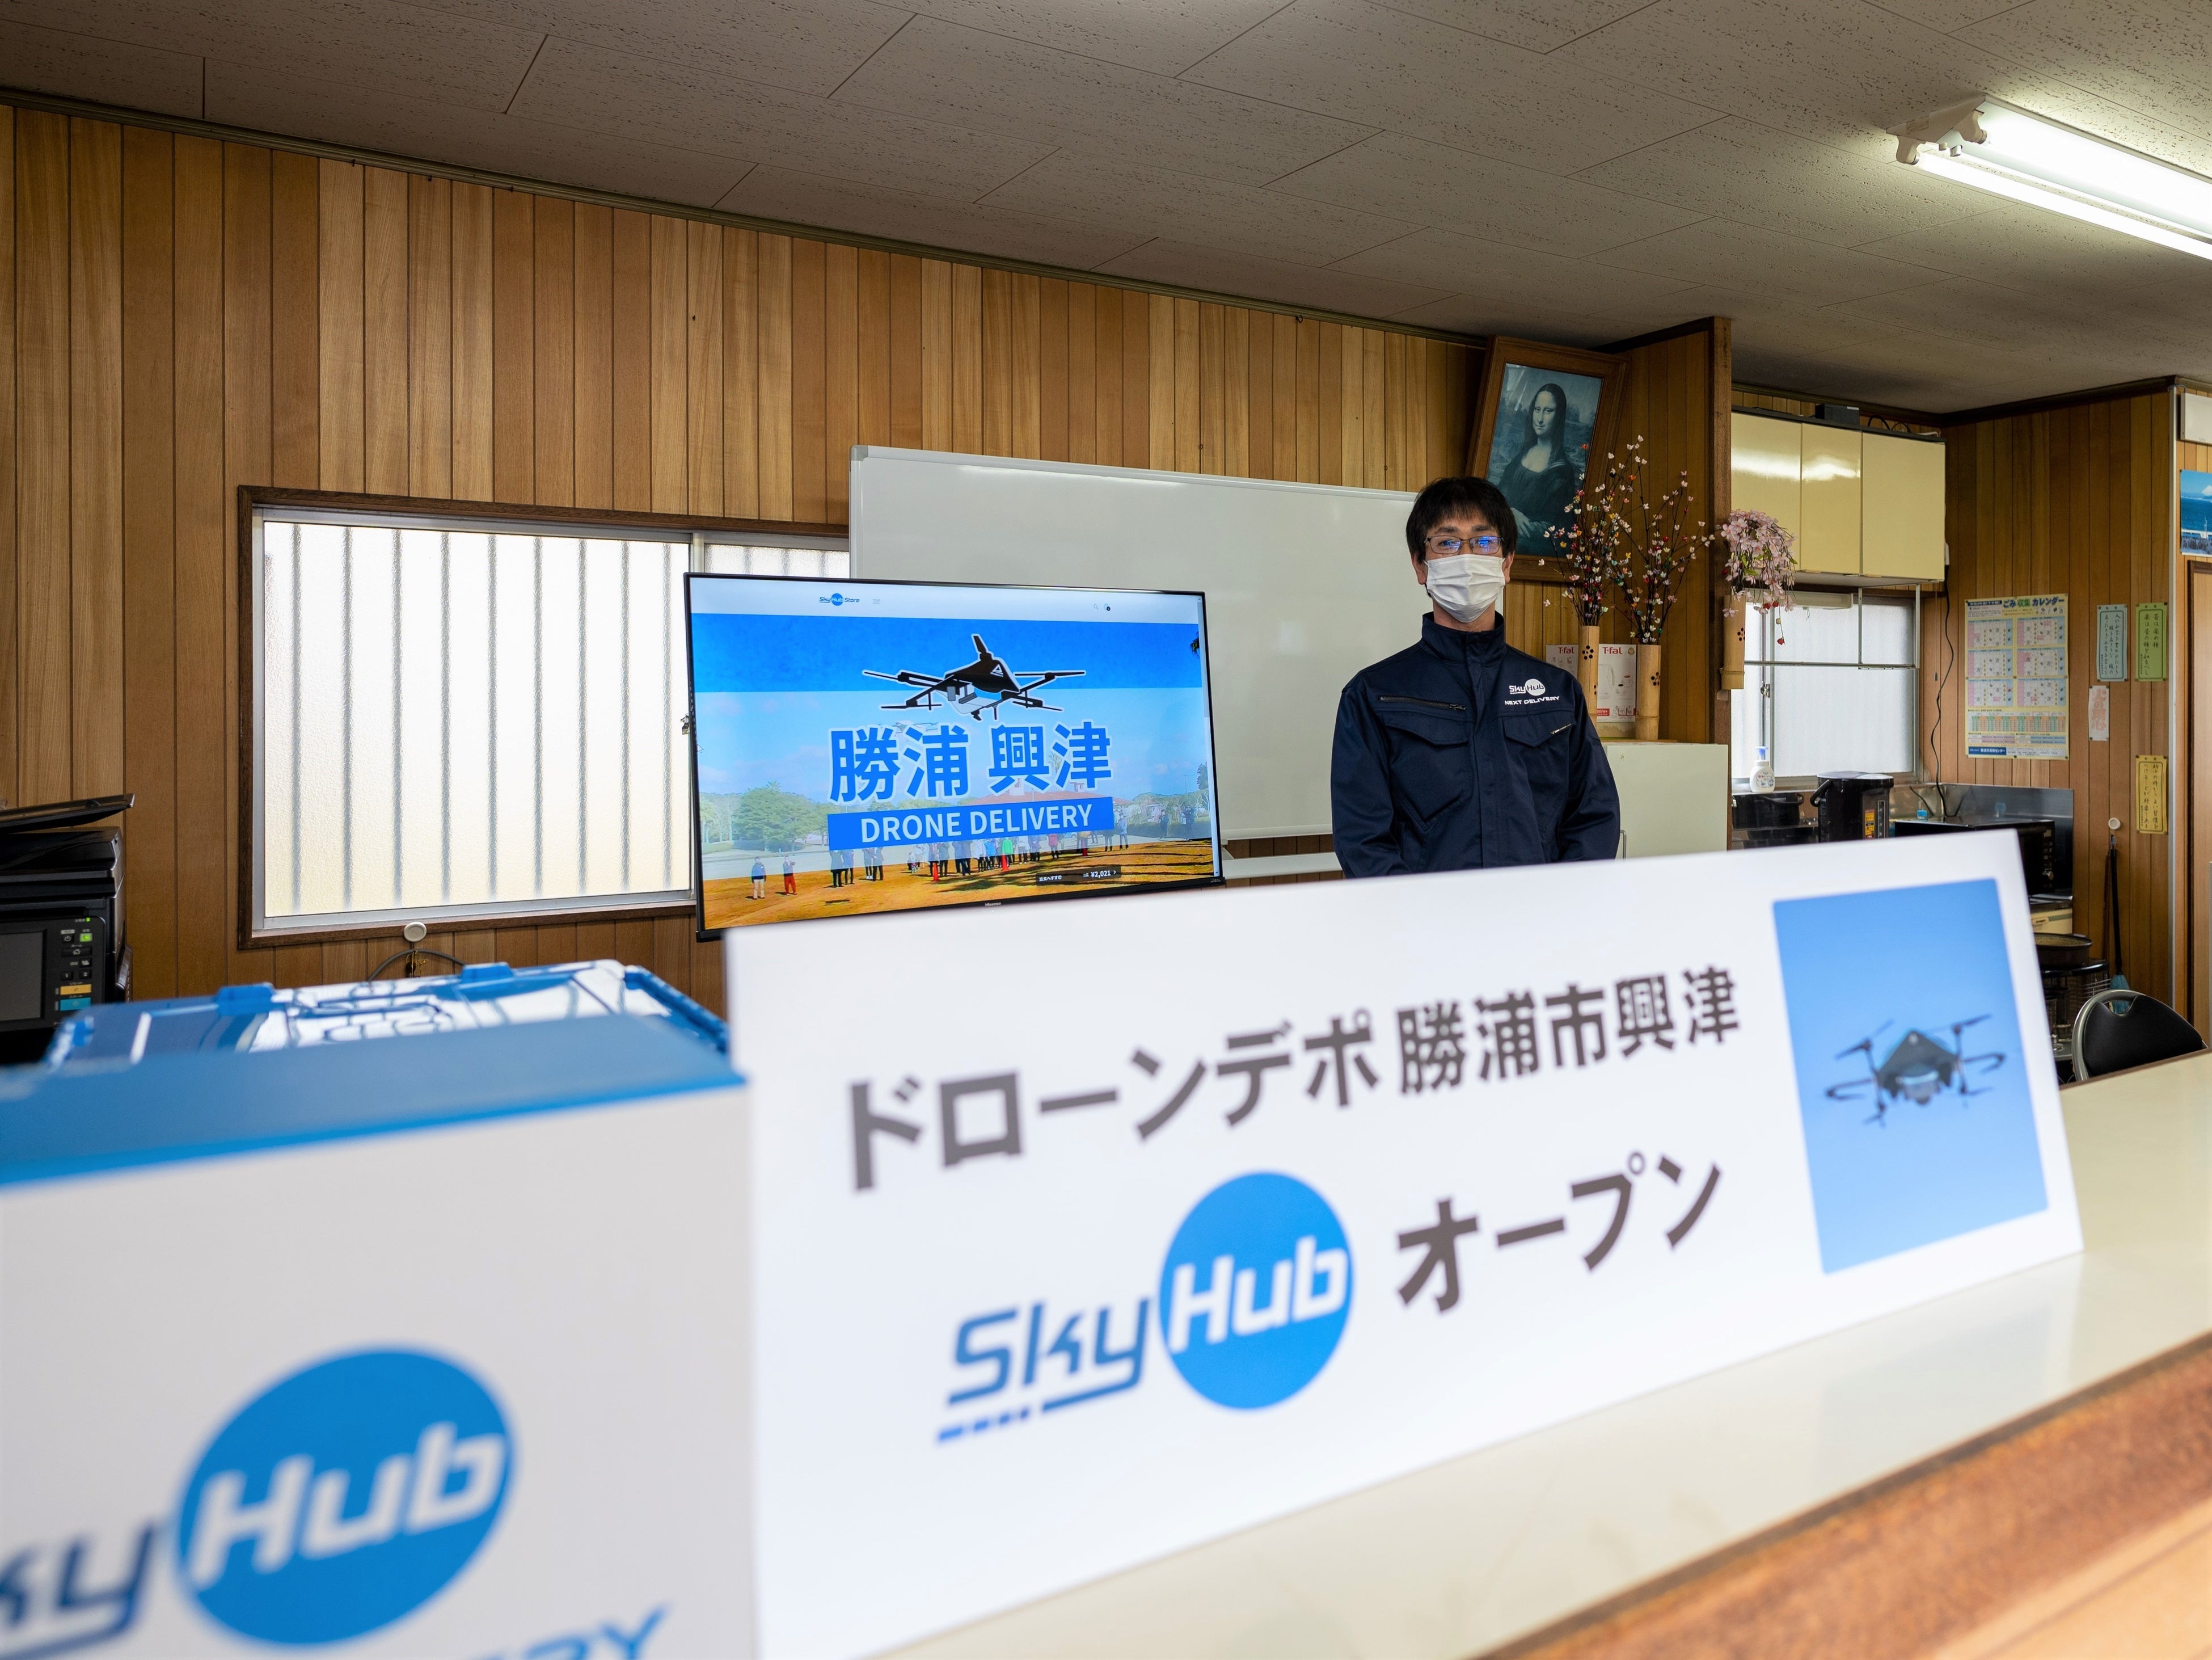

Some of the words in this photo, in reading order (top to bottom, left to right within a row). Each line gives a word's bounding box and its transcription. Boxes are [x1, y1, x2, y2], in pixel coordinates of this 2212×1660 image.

[1523, 696, 1560, 705] DELIVERY
[2091, 689, 2107, 731] 火の用心
[830, 724, 969, 802] 勝浦
[989, 721, 1112, 793] 興津
[860, 812, 962, 843] DRONE
[970, 804, 1093, 833] DELIVERY
[1091, 870, 1111, 878] ¥2,021
[849, 1008, 1379, 1193] ドローンデポ
[1394, 966, 1742, 1096] 勝浦市興津
[1396, 1151, 1723, 1313] オープン
